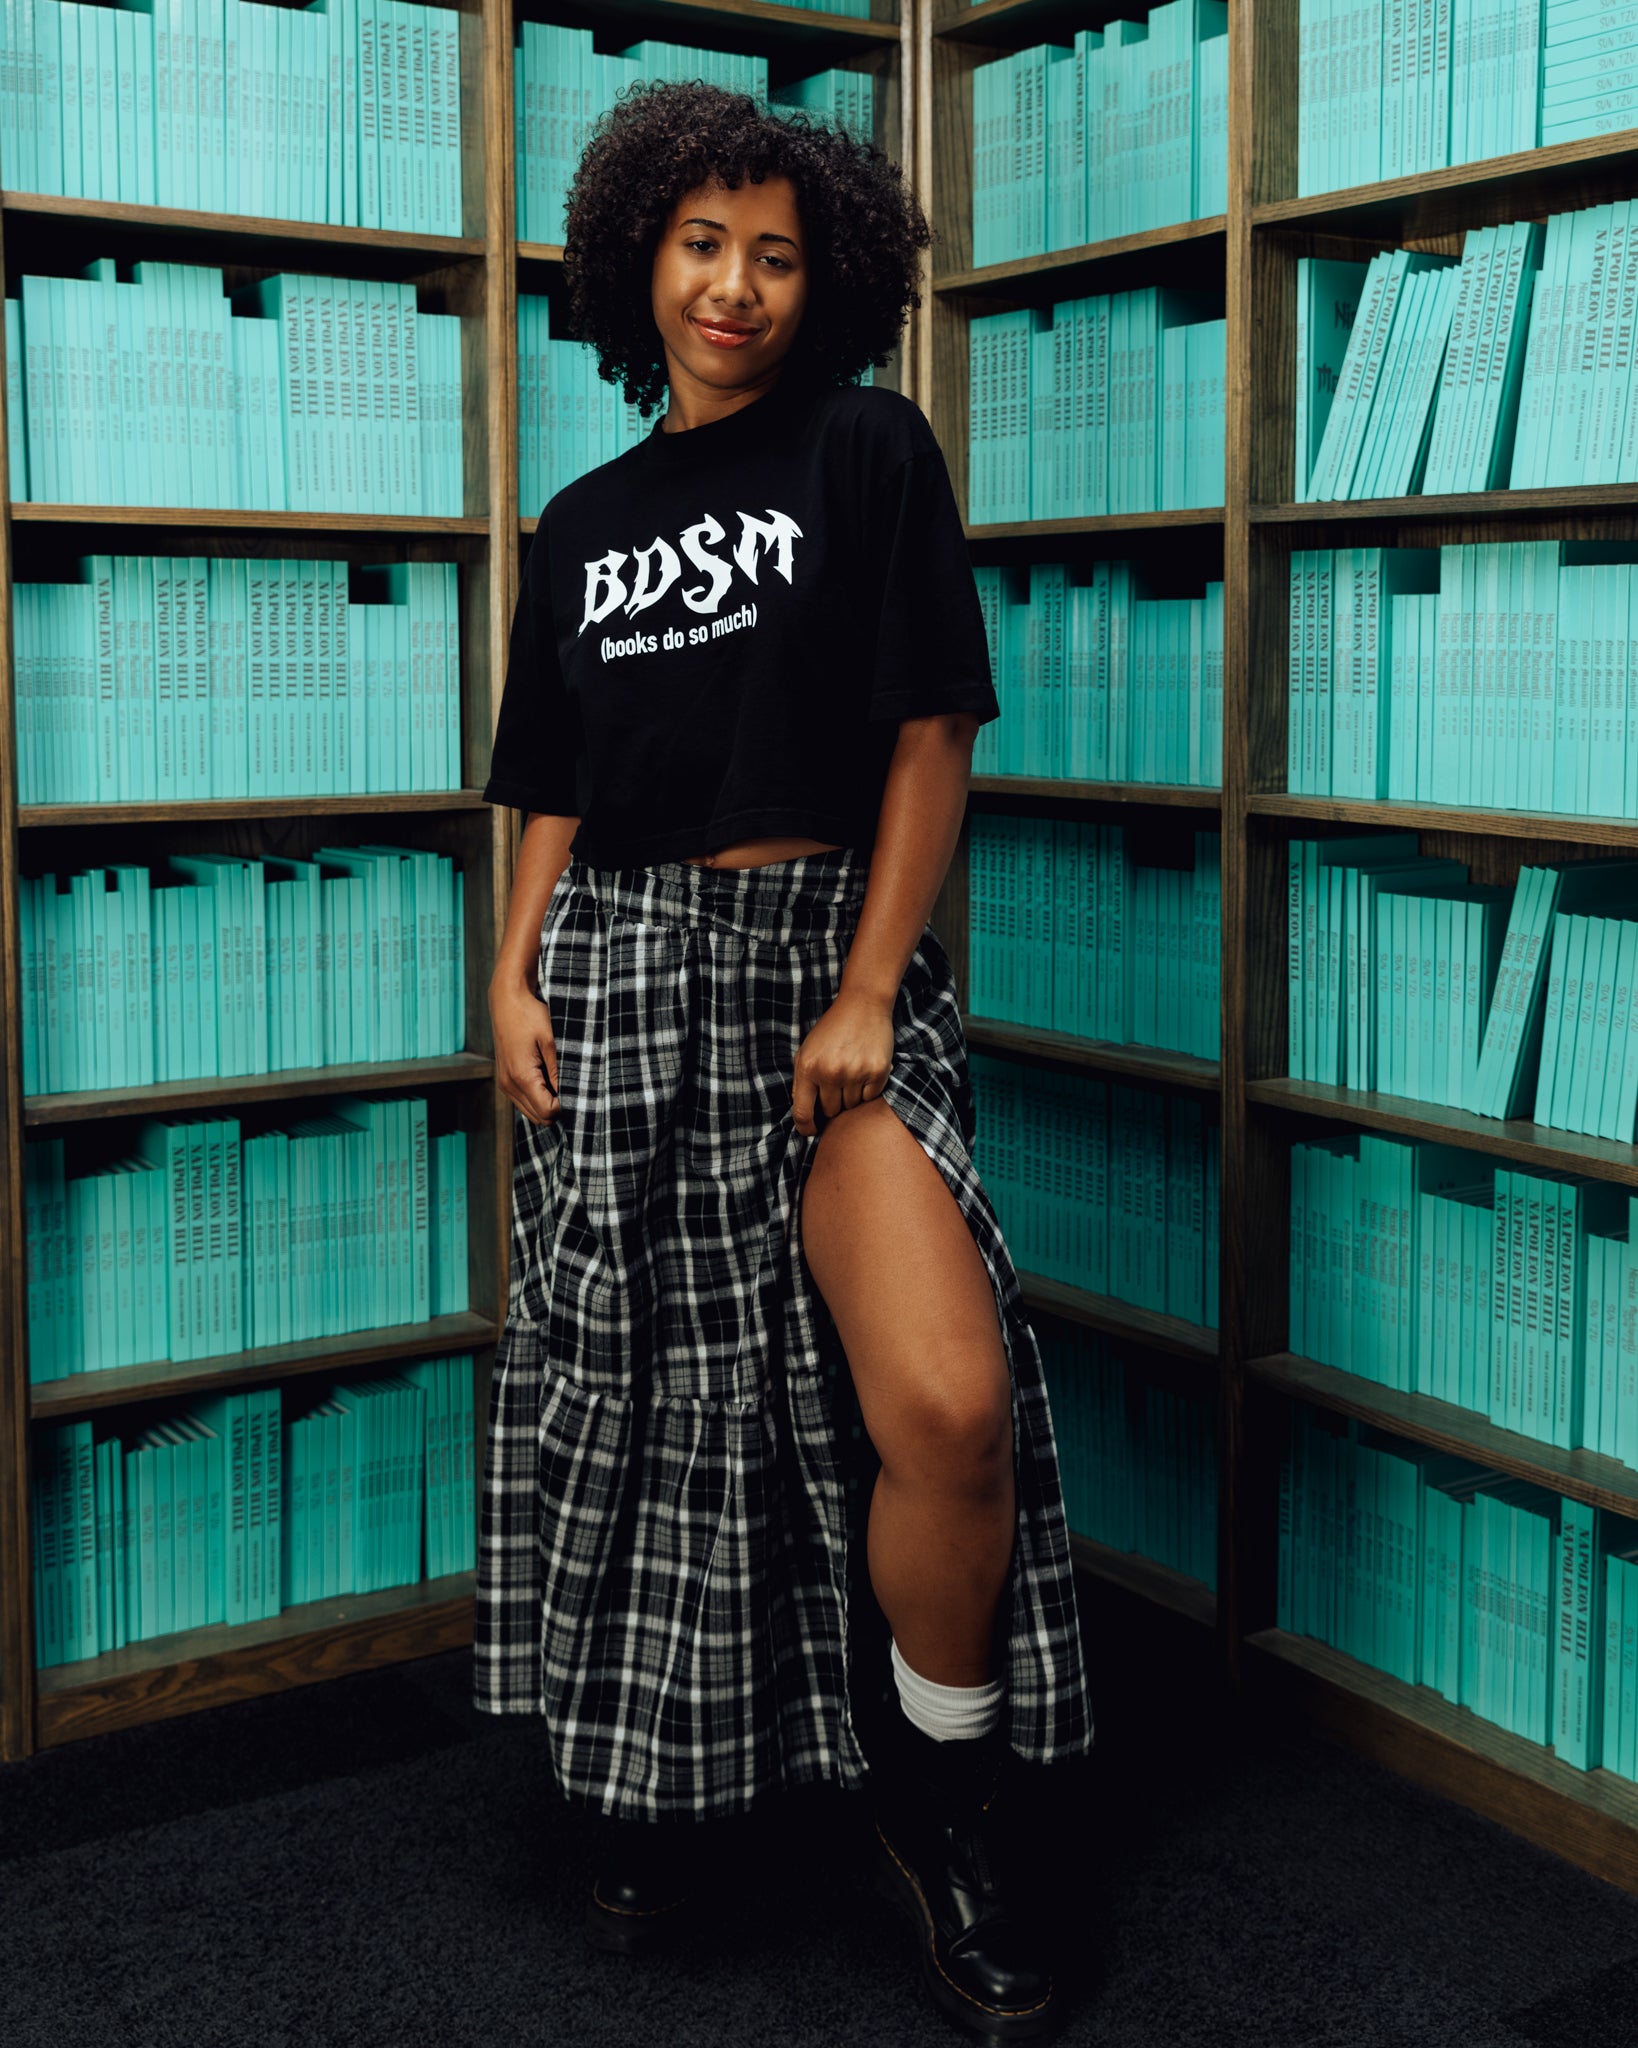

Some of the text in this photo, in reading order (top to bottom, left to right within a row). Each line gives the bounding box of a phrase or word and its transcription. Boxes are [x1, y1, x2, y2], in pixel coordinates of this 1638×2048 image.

[1391, 44, 1401, 88] HILL
[1407, 38, 1416, 82] HILL
[1421, 34, 1431, 80] HILL
[1437, 30, 1447, 76] HILL
[1598, 32, 1634, 50] SUN TZU
[1599, 52, 1635, 70] SUN TZU
[1600, 9, 1637, 28] SUN TZU
[363, 20, 374, 141] NAPOLEON HILL
[380, 22, 392, 142] NAPOLEON HILL
[397, 24, 408, 144] NAPOLEON HILL
[413, 28, 425, 146] NAPOLEON HILL
[430, 30, 441, 148] NAPOLEON HILL
[446, 32, 457, 151] NAPOLEON HILL
[1596, 74, 1632, 91] SUN TZU
[1596, 94, 1632, 112] SUN TZU
[1596, 114, 1632, 130] SUN TZU
[287, 296, 302, 418] NAPOLEON HILL
[304, 297, 318, 418] NAPOLEON HILL
[321, 298, 335, 419] NAPOLEON HILL
[1346, 273, 1385, 402] NAPOLEON HILL
[1360, 273, 1400, 402] NAPOLEON HILL
[1443, 255, 1474, 391] NAPOLEON HILL
[1458, 252, 1489, 389] NAPOLEON HILL
[1474, 249, 1506, 386] NAPOLEON HILL
[1490, 246, 1522, 385] NAPOLEON HILL
[1581, 229, 1607, 375] NAPOLEON HILL
[1598, 226, 1625, 372] NAPOLEON HILL
[1615, 325, 1631, 372] HILL
[338, 300, 352, 420] NAPOLEON HILL
[354, 301, 368, 421] NAPOLEON HILL
[371, 303, 384, 422] NAPOLEON HILL
[387, 303, 400, 422] NAPOLEON HILL
[404, 305, 416, 424] NAPOLEON HILL
[577, 509, 804, 638] BDSM
[600, 602, 758, 663] (books do so much)
[1305, 571, 1315, 696] NAPOLEON HILL
[1352, 570, 1363, 697] NAPOLEON HILL
[98, 578, 112, 703] NAPOLEON HILL
[158, 579, 170, 702] NAPOLEON HILL
[176, 579, 188, 702] NAPOLEON HILL
[194, 579, 206, 702] NAPOLEON HILL
[252, 580, 262, 701] NAPOLEON HILL
[269, 581, 280, 701] NAPOLEON HILL
[286, 581, 296, 701] NAPOLEON HILL
[303, 581, 313, 700] NAPOLEON HILL
[319, 582, 329, 701] NAPOLEON HILL
[336, 582, 346, 701] NAPOLEON HILL
[1291, 573, 1301, 696] NAPOLEON HILL
[1320, 572, 1329, 696] NAPOLEON HILL
[1366, 570, 1377, 698] NAPOLEON HILL
[1291, 862, 1299, 982] NAPOLEON HILL
[1548, 978, 1560, 1019] SUN TZU
[1565, 979, 1578, 1021] SUN TZU
[1582, 982, 1594, 1024] SUN TZU
[1598, 984, 1610, 1026] SUN TZU
[1615, 986, 1627, 1029] SUN TZU
[174, 1146, 186, 1267] NAPOLEON HILL
[191, 1144, 204, 1264] NAPOLEON HILL
[209, 1142, 221, 1262] NAPOLEON HILL
[227, 1141, 238, 1260] NAPOLEON HILL
[415, 1121, 426, 1234] NAPOLEON HILL
[1494, 1192, 1506, 1323] NAPOLEON HILL
[1511, 1196, 1523, 1327] NAPOLEON HILL
[1527, 1200, 1539, 1332] NAPOLEON HILL
[1543, 1203, 1555, 1336] NAPOLEON HILL
[1559, 1207, 1572, 1341] NAPOLEON HILL
[233, 1415, 244, 1535] NAPOLEON HILL
[251, 1413, 261, 1531] NAPOLEON HILL
[268, 1409, 278, 1526] NAPOLEON HILL
[1561, 1521, 1574, 1654] NAPOLEON HILL
[1576, 1527, 1589, 1661] NAPOLEON HILL
